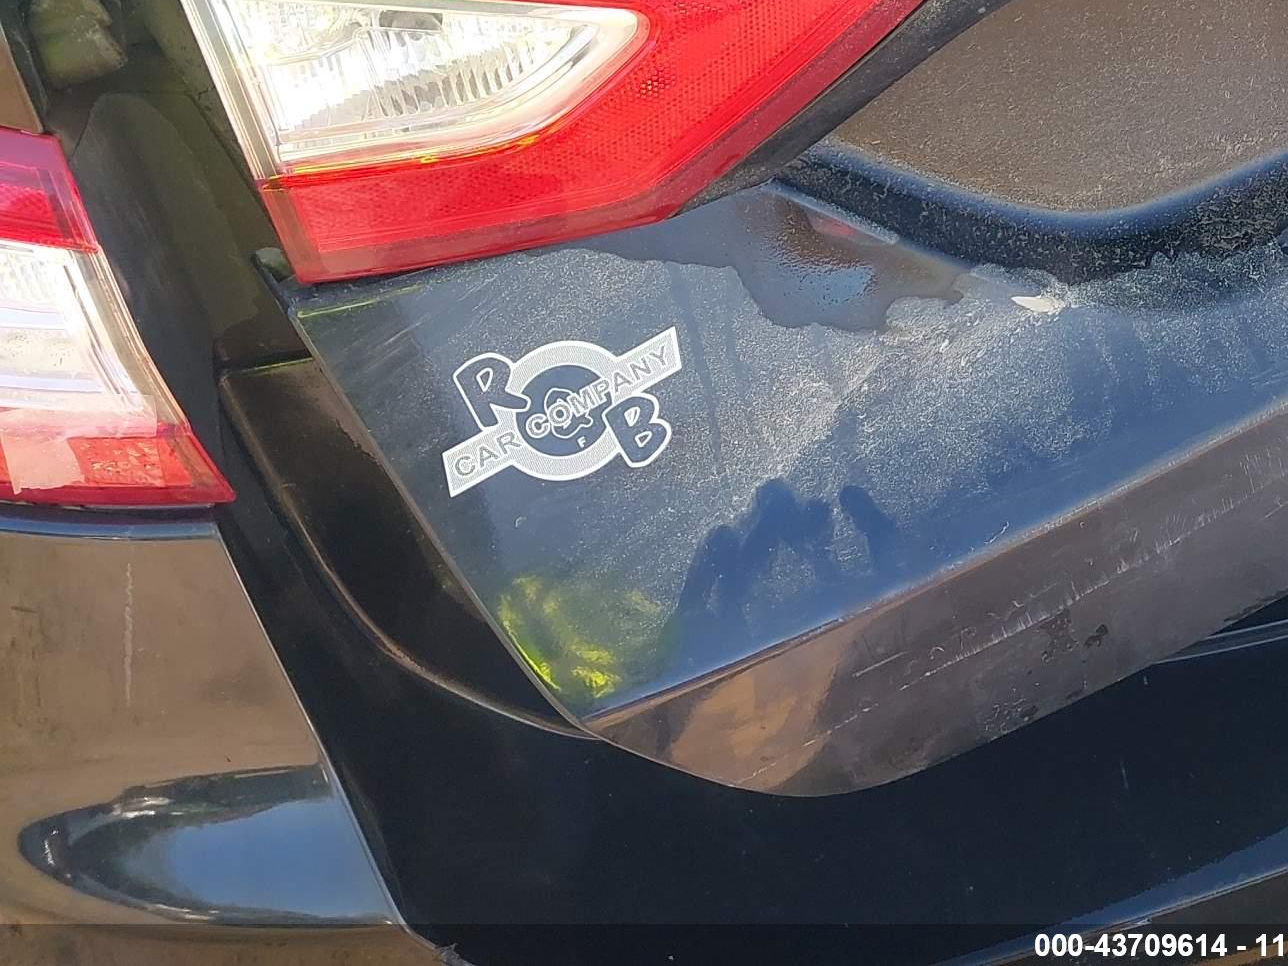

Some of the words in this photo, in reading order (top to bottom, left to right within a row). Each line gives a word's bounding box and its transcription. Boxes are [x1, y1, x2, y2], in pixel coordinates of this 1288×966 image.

[453, 352, 531, 434] R
[602, 391, 673, 468] B
[454, 431, 524, 478] CAR
[525, 345, 669, 439] COMPANY
